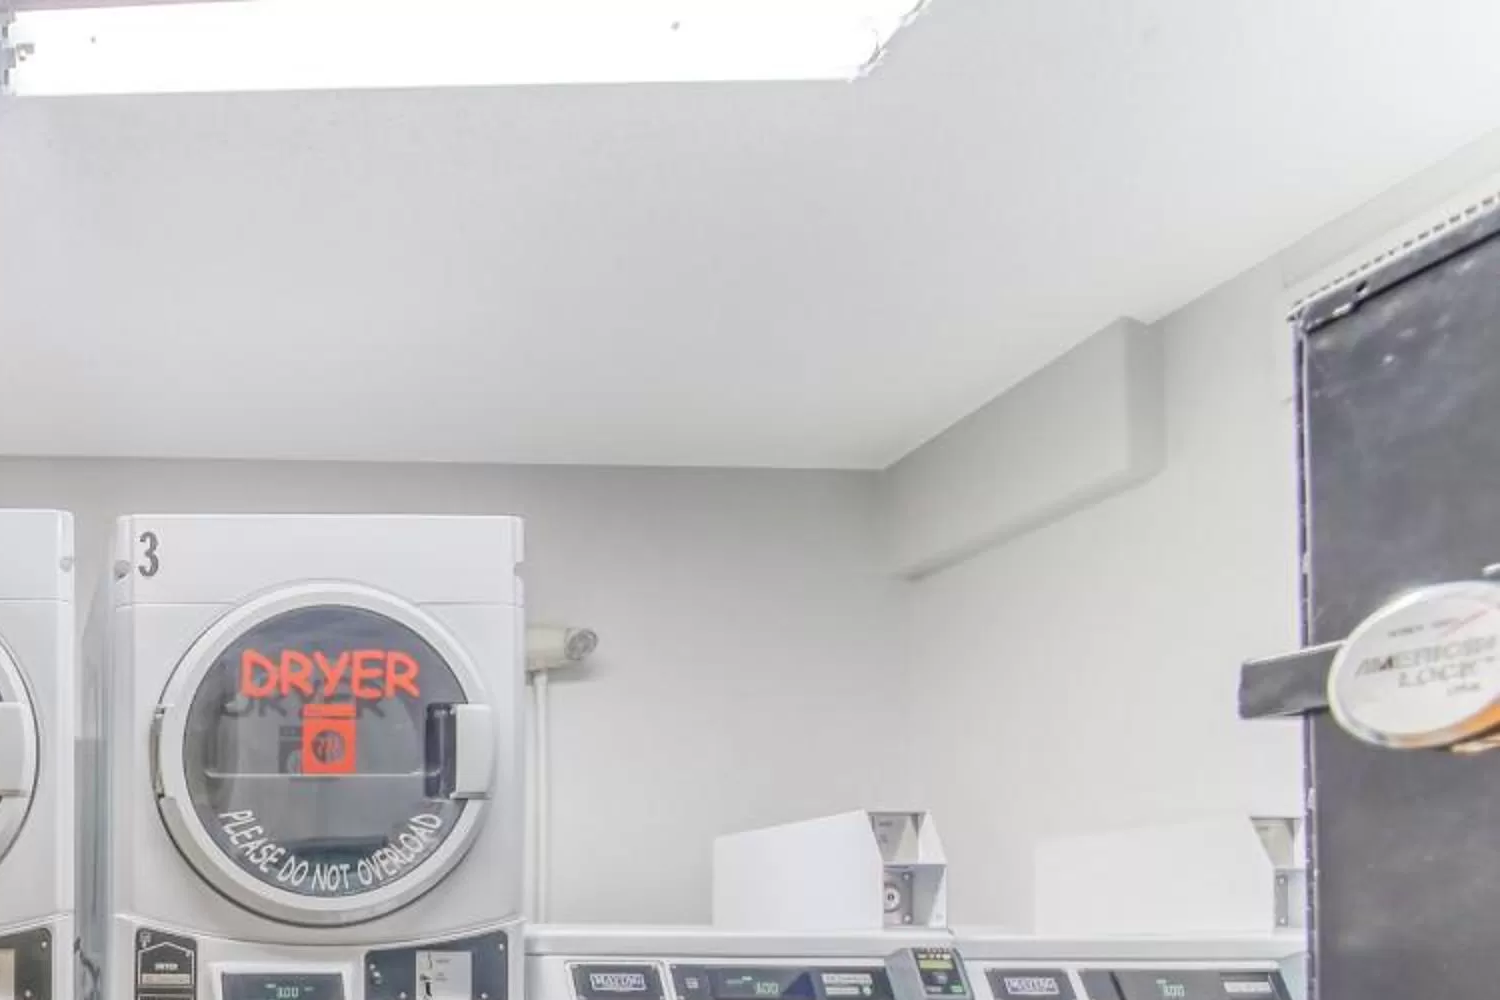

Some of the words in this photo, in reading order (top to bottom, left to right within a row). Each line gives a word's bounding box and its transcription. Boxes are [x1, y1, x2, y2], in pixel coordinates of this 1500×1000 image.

[138, 531, 160, 577] 3
[240, 648, 422, 700] DRYER
[218, 808, 285, 873] PLEASE
[278, 856, 311, 886] DO
[311, 863, 351, 892] NOT
[357, 812, 444, 886] OVERLOAD
